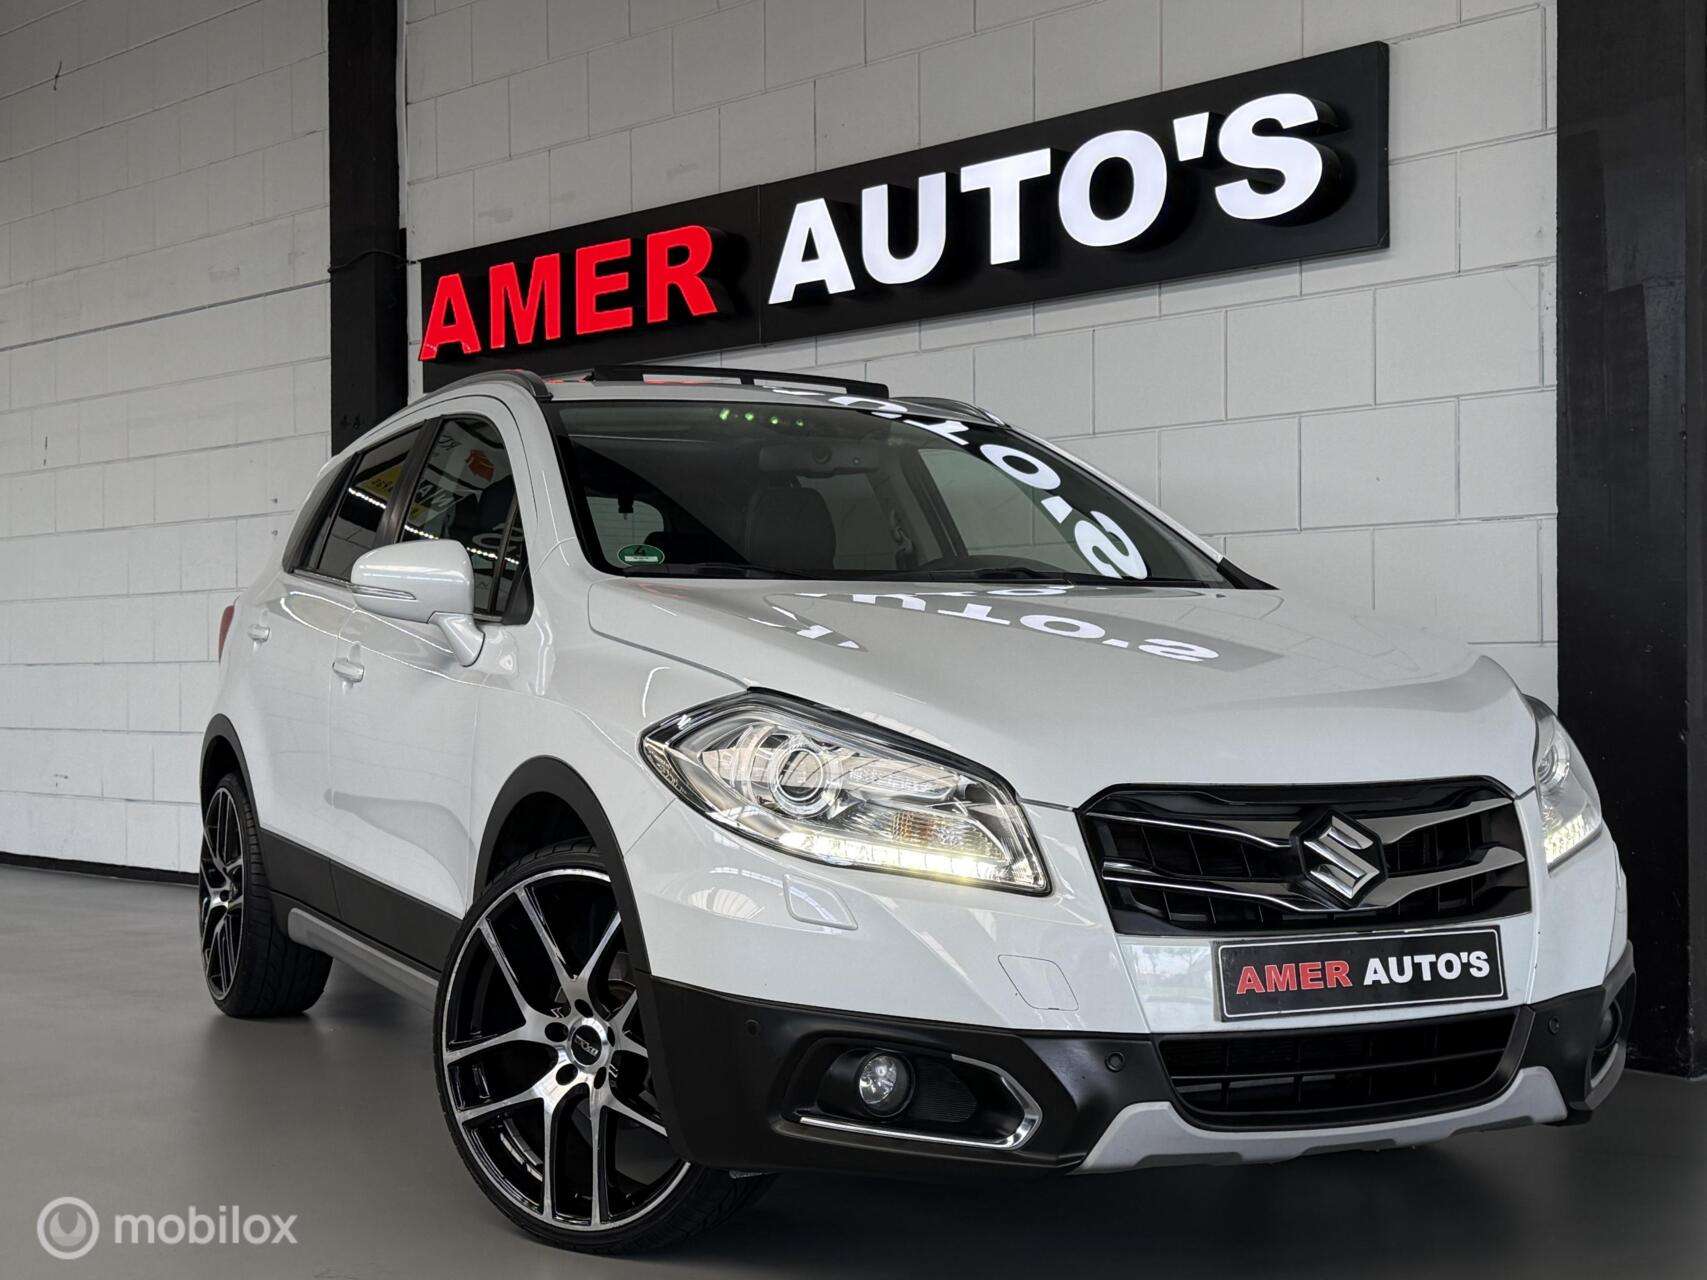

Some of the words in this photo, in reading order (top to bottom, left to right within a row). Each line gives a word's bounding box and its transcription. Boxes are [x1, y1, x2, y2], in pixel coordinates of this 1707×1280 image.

[419, 224, 718, 361] AMER
[769, 93, 1325, 304] AUTO'S
[1236, 959, 1353, 995] AMER
[1363, 950, 1491, 986] AUTO'S
